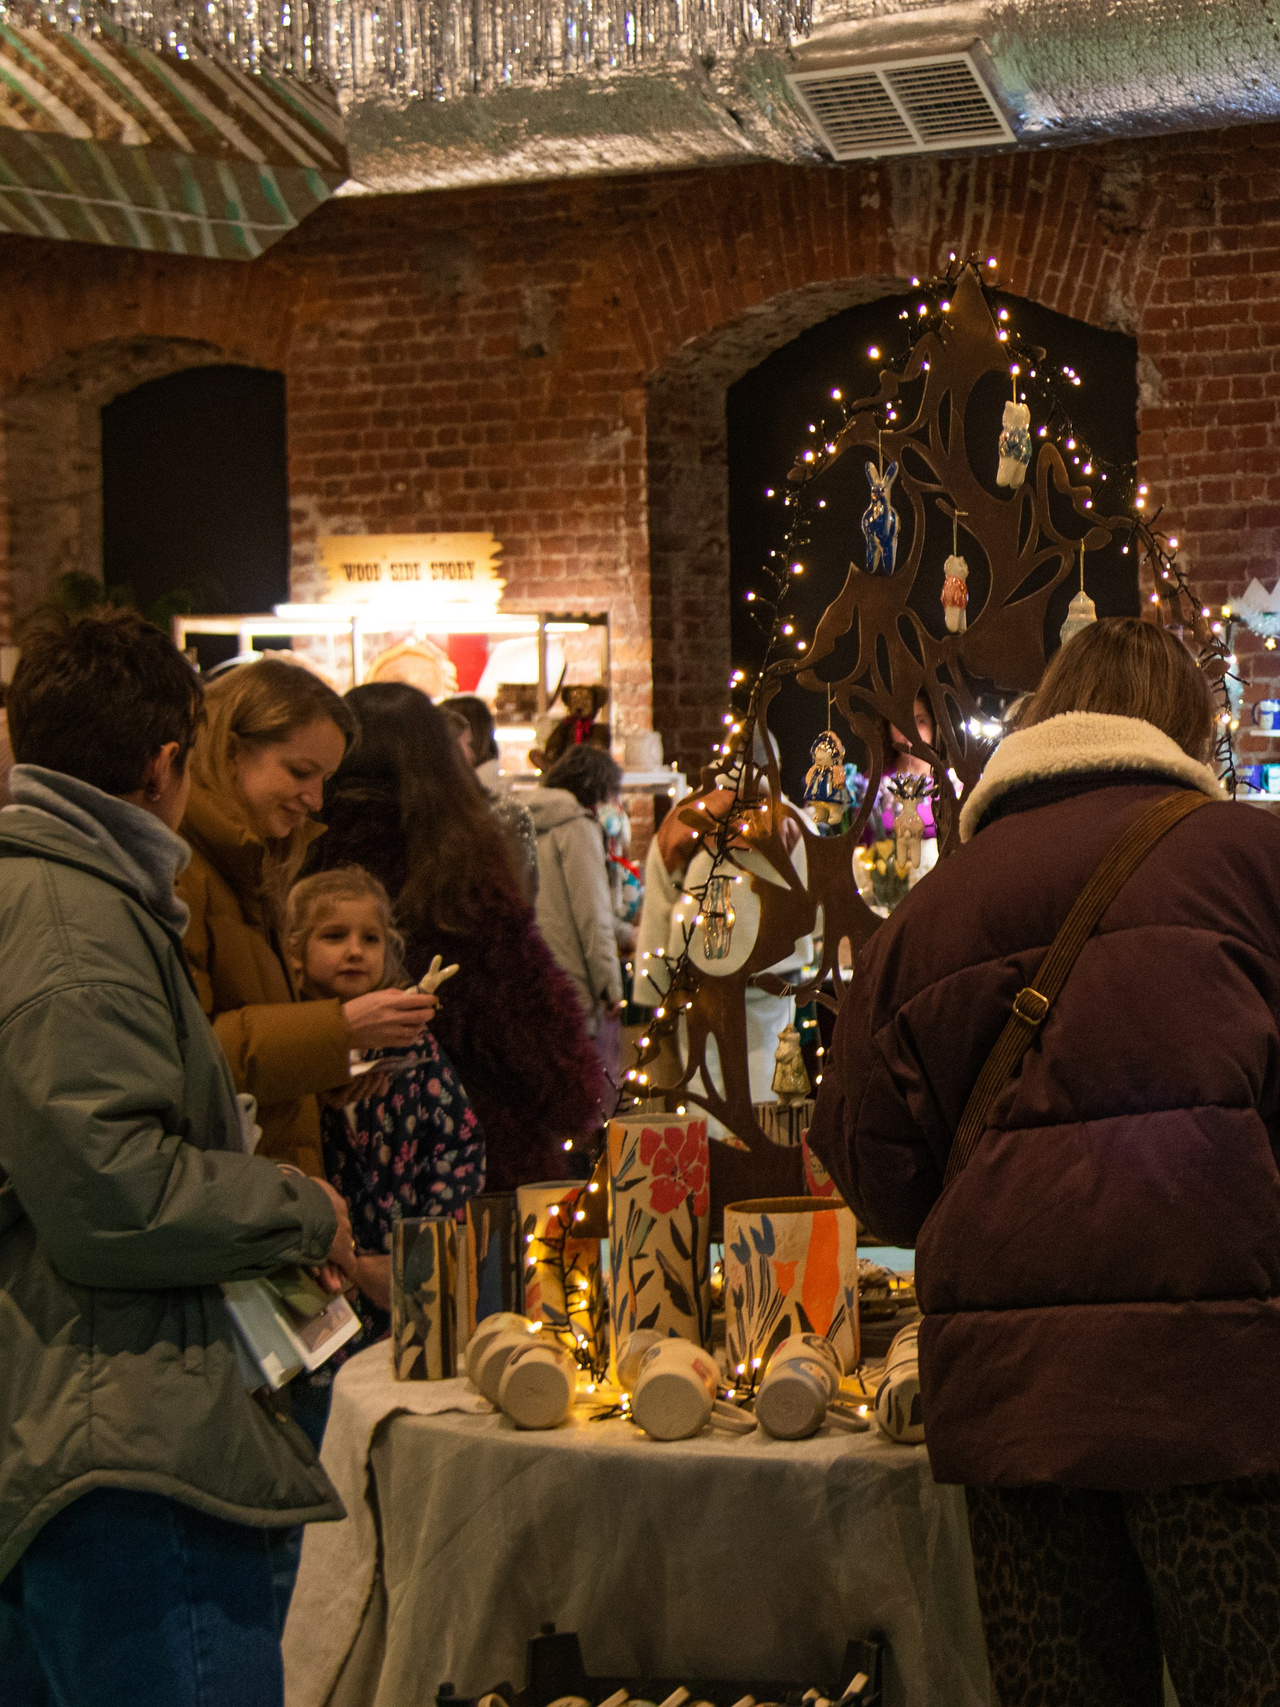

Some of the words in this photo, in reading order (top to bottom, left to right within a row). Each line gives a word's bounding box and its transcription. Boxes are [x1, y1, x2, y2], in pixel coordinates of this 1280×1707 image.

[342, 562, 381, 581] WOOD
[390, 562, 421, 581] SIDE
[430, 561, 475, 580] STORY
